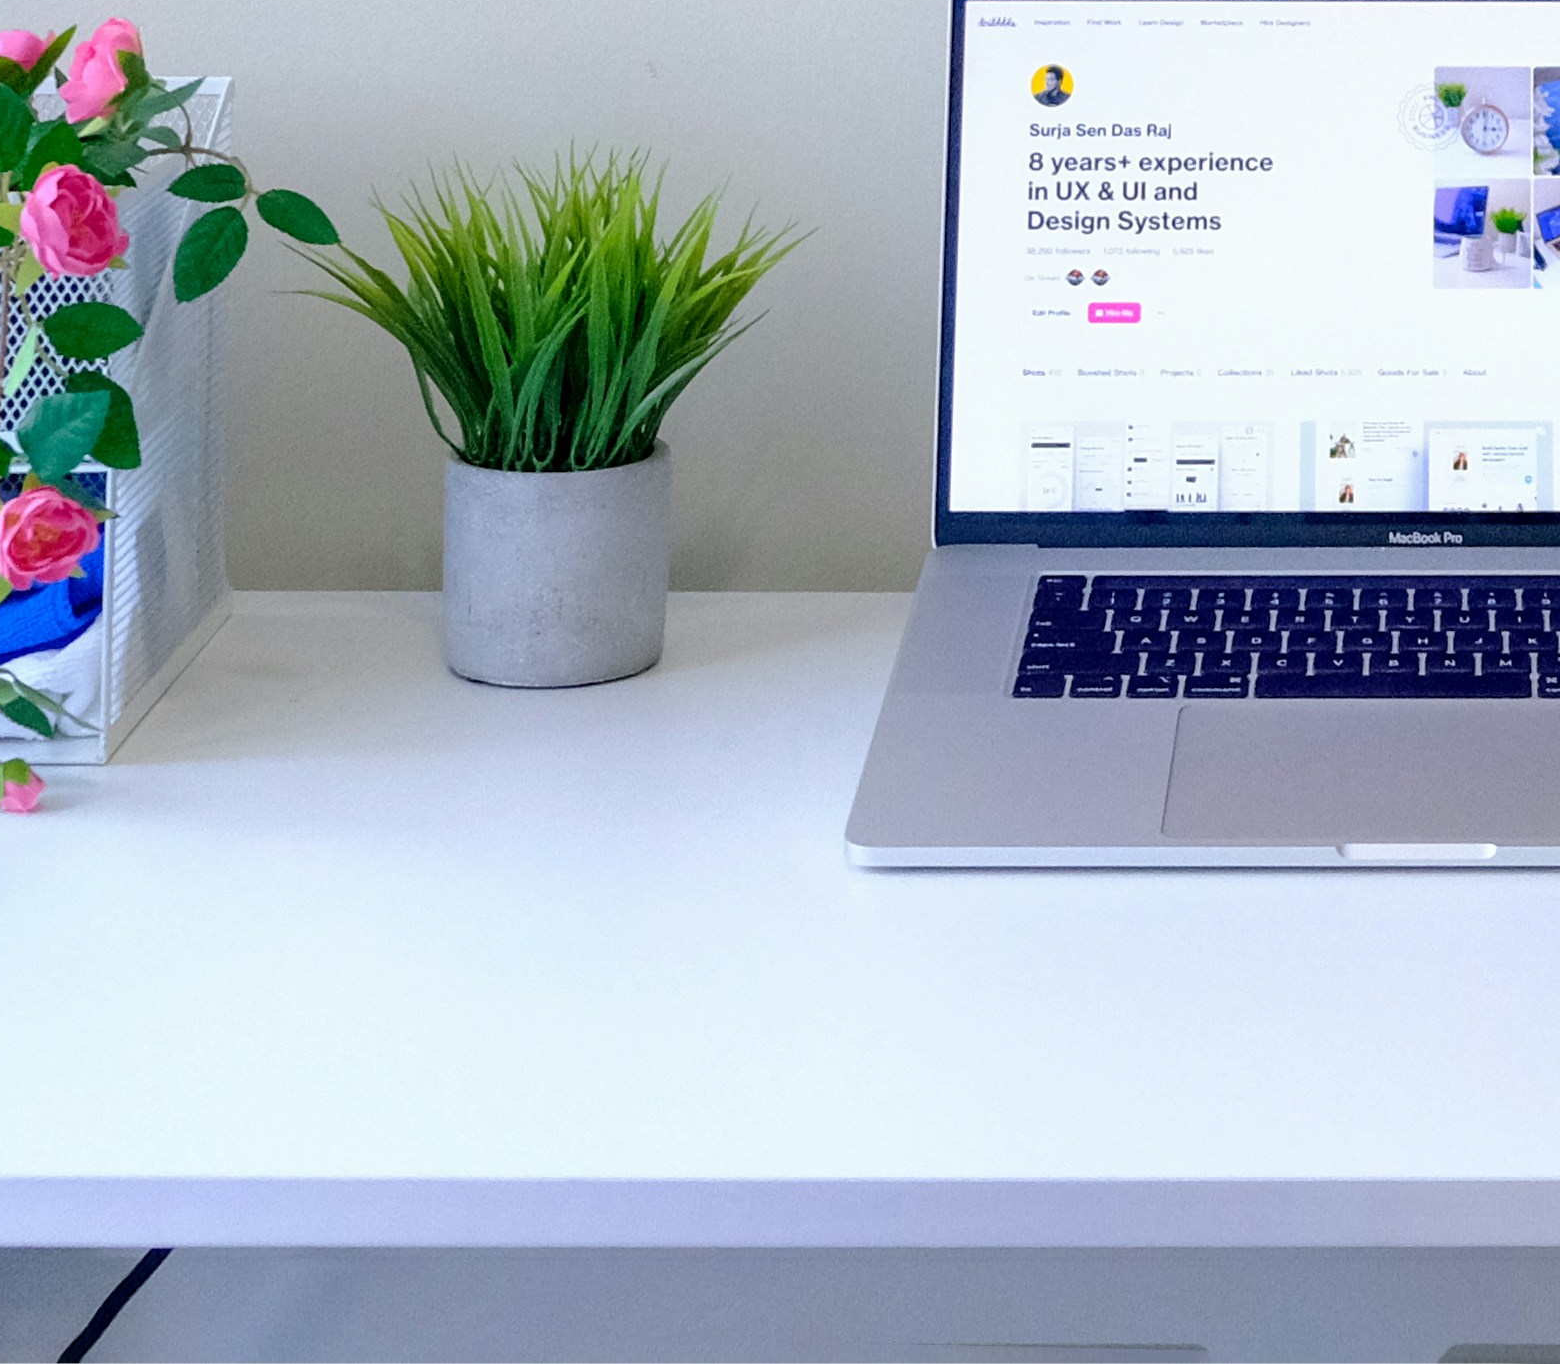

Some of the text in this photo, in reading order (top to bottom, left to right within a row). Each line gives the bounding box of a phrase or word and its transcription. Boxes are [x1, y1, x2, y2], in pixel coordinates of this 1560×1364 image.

[1029, 123, 1172, 140] Surja Sen Das Raj
[1028, 152, 1274, 175] 8 years+ experience
[1027, 181, 1198, 201] in UX & UI and
[1027, 210, 1223, 234] Design Systems
[1388, 530, 1464, 544] MacBook Pro
